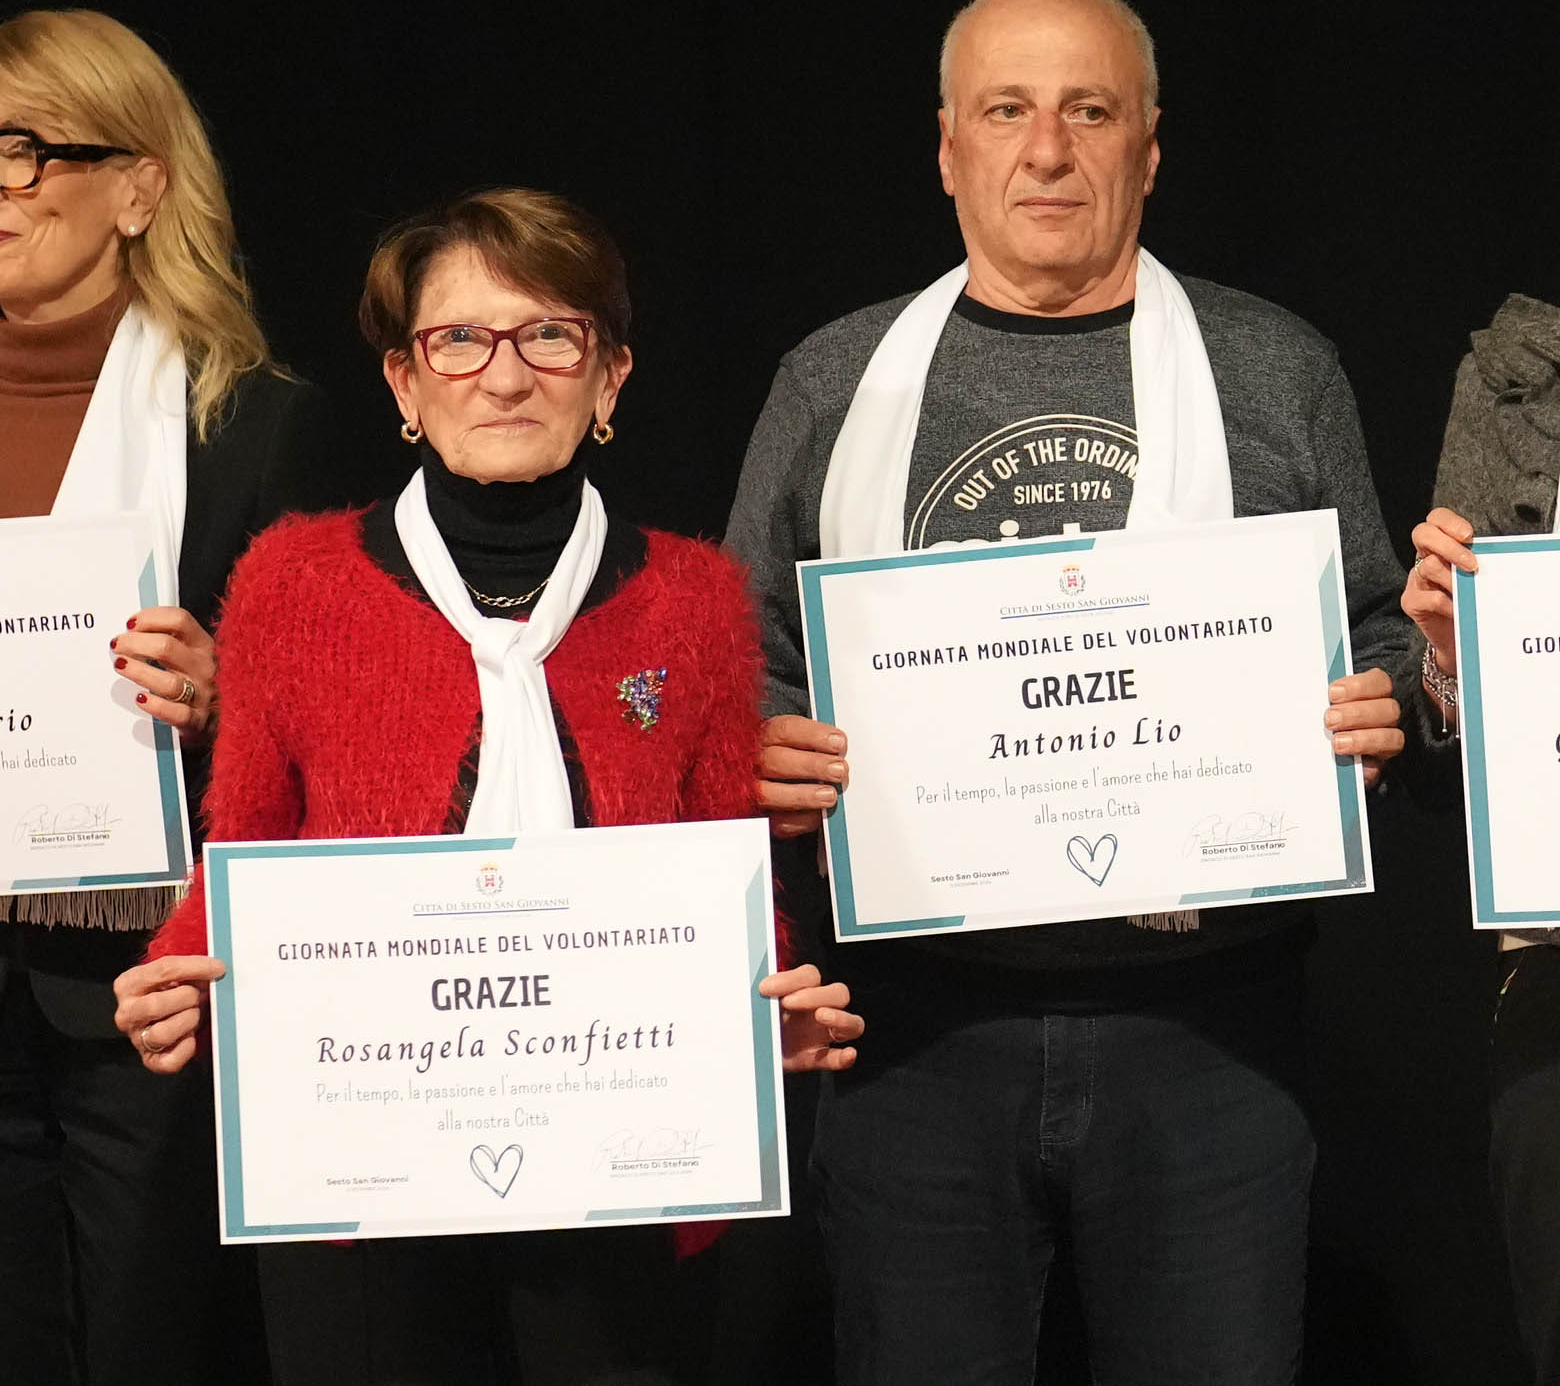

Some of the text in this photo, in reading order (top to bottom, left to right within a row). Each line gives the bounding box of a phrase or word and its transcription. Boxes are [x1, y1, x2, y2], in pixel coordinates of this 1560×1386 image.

[953, 436, 1138, 512] OUT OF THE ORDIN
[1013, 479, 1112, 505] SINCE 1976
[871, 644, 969, 671] GIORNATA
[976, 634, 1075, 661] MONDIALE
[1081, 630, 1118, 651] DEL
[1124, 615, 1273, 646] VOLONTARIATO
[1020, 667, 1139, 711] GRAZIE
[987, 716, 1182, 760] Antonio Lio
[0, 749, 21, 771] hai
[22, 745, 78, 769] dedicato
[914, 784, 940, 805] Per
[941, 780, 952, 803] il
[953, 787, 1001, 805] tempo,
[1003, 775, 1017, 797] la
[1019, 777, 1079, 801] passione
[1080, 777, 1090, 790] e
[1144, 760, 1169, 784] che
[1170, 758, 1193, 781] hai
[1195, 755, 1253, 779] dedicato
[1033, 801, 1059, 826] alla
[1060, 806, 1105, 823] nostra
[1200, 845, 1239, 856] Roberto
[1249, 841, 1286, 852] Stefano
[277, 924, 696, 962] GIORNATA MONDIALE DEL VOLONTARIATO
[430, 973, 552, 1012] GRAZIE
[315, 1018, 675, 1075] Rosangela Sconfietti
[314, 1082, 343, 1104] Per
[342, 1078, 353, 1103] il
[355, 1087, 405, 1107] tempo,
[406, 1076, 421, 1101] la
[423, 1083, 486, 1106] passione
[487, 1084, 498, 1097] e
[555, 1069, 582, 1094] che
[583, 1068, 606, 1092] hai
[607, 1067, 669, 1091] dedicato
[436, 1107, 463, 1132] alla
[465, 1115, 512, 1131] nostra
